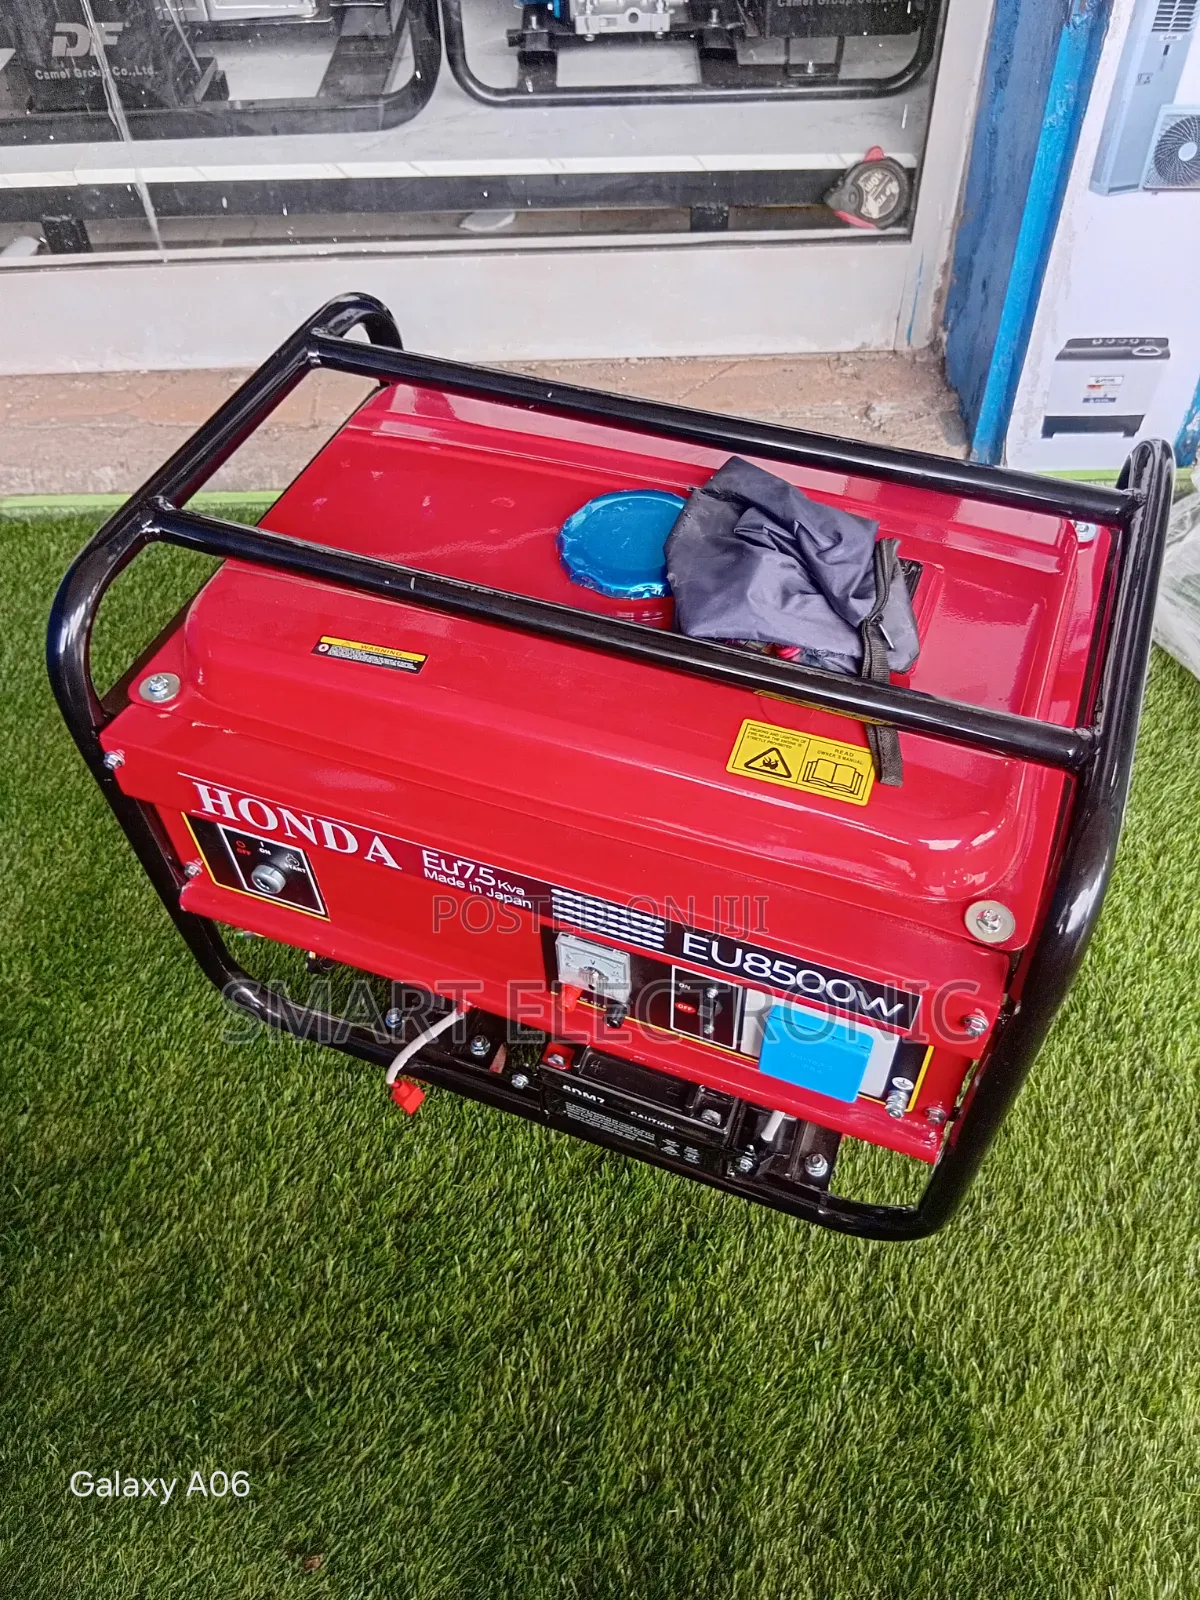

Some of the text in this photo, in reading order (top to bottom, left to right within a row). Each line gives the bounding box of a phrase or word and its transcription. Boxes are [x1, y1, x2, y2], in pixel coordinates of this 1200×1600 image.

[52, 22, 123, 57] DF
[35, 67, 71, 80] Camel
[74, 67, 107, 79] Grou
[360, 644, 403, 657] WARNING
[834, 748, 855, 758] READ
[841, 756, 865, 765] MANUAL
[192, 782, 403, 870] HONDA
[423, 867, 533, 910] Made in Japan
[678, 982, 691, 991] ON
[677, 1003, 694, 1012] OFF
[630, 1111, 675, 1130] CAUTION
